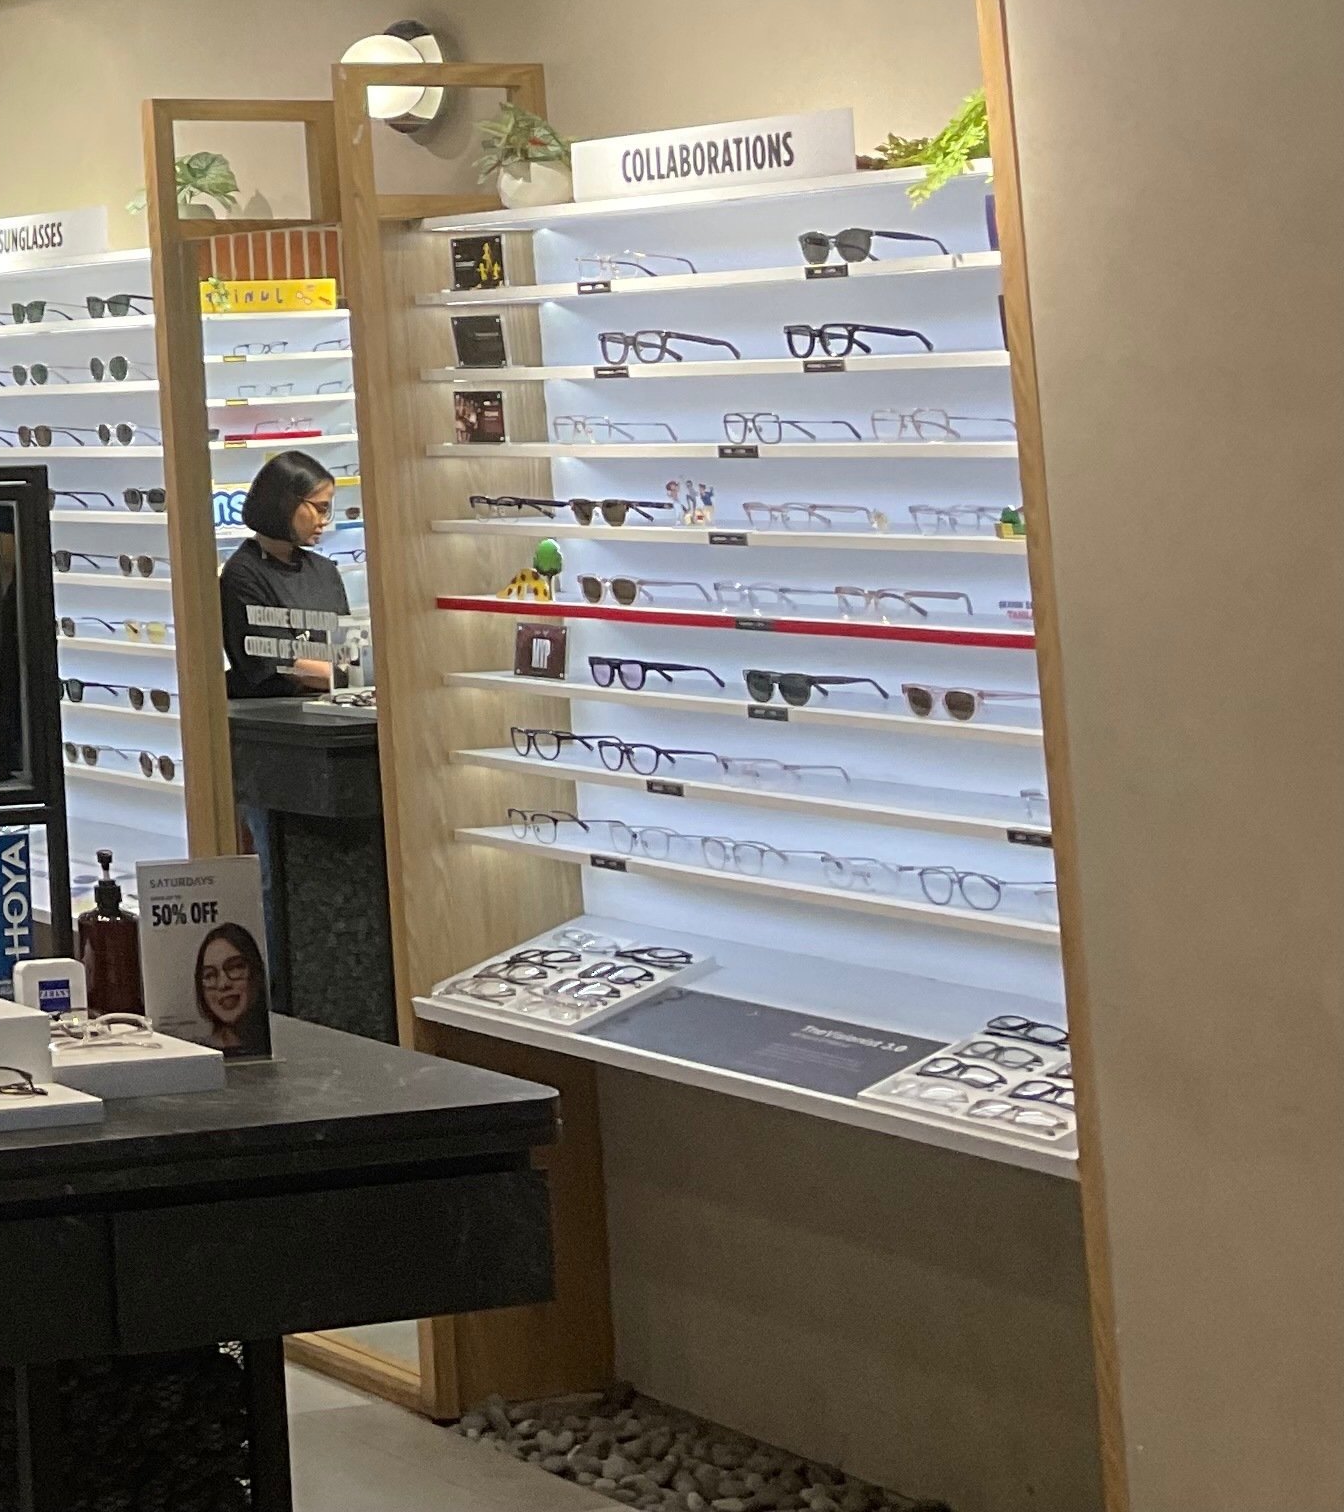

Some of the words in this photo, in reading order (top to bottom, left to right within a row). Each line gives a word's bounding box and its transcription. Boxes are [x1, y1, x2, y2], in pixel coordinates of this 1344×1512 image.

[621, 131, 794, 182] COLLABORATIONS
[1, 839, 30, 961] HOYA
[149, 876, 214, 888] SATURDAYS
[152, 903, 188, 926] 50%
[191, 901, 218, 924] OFF
